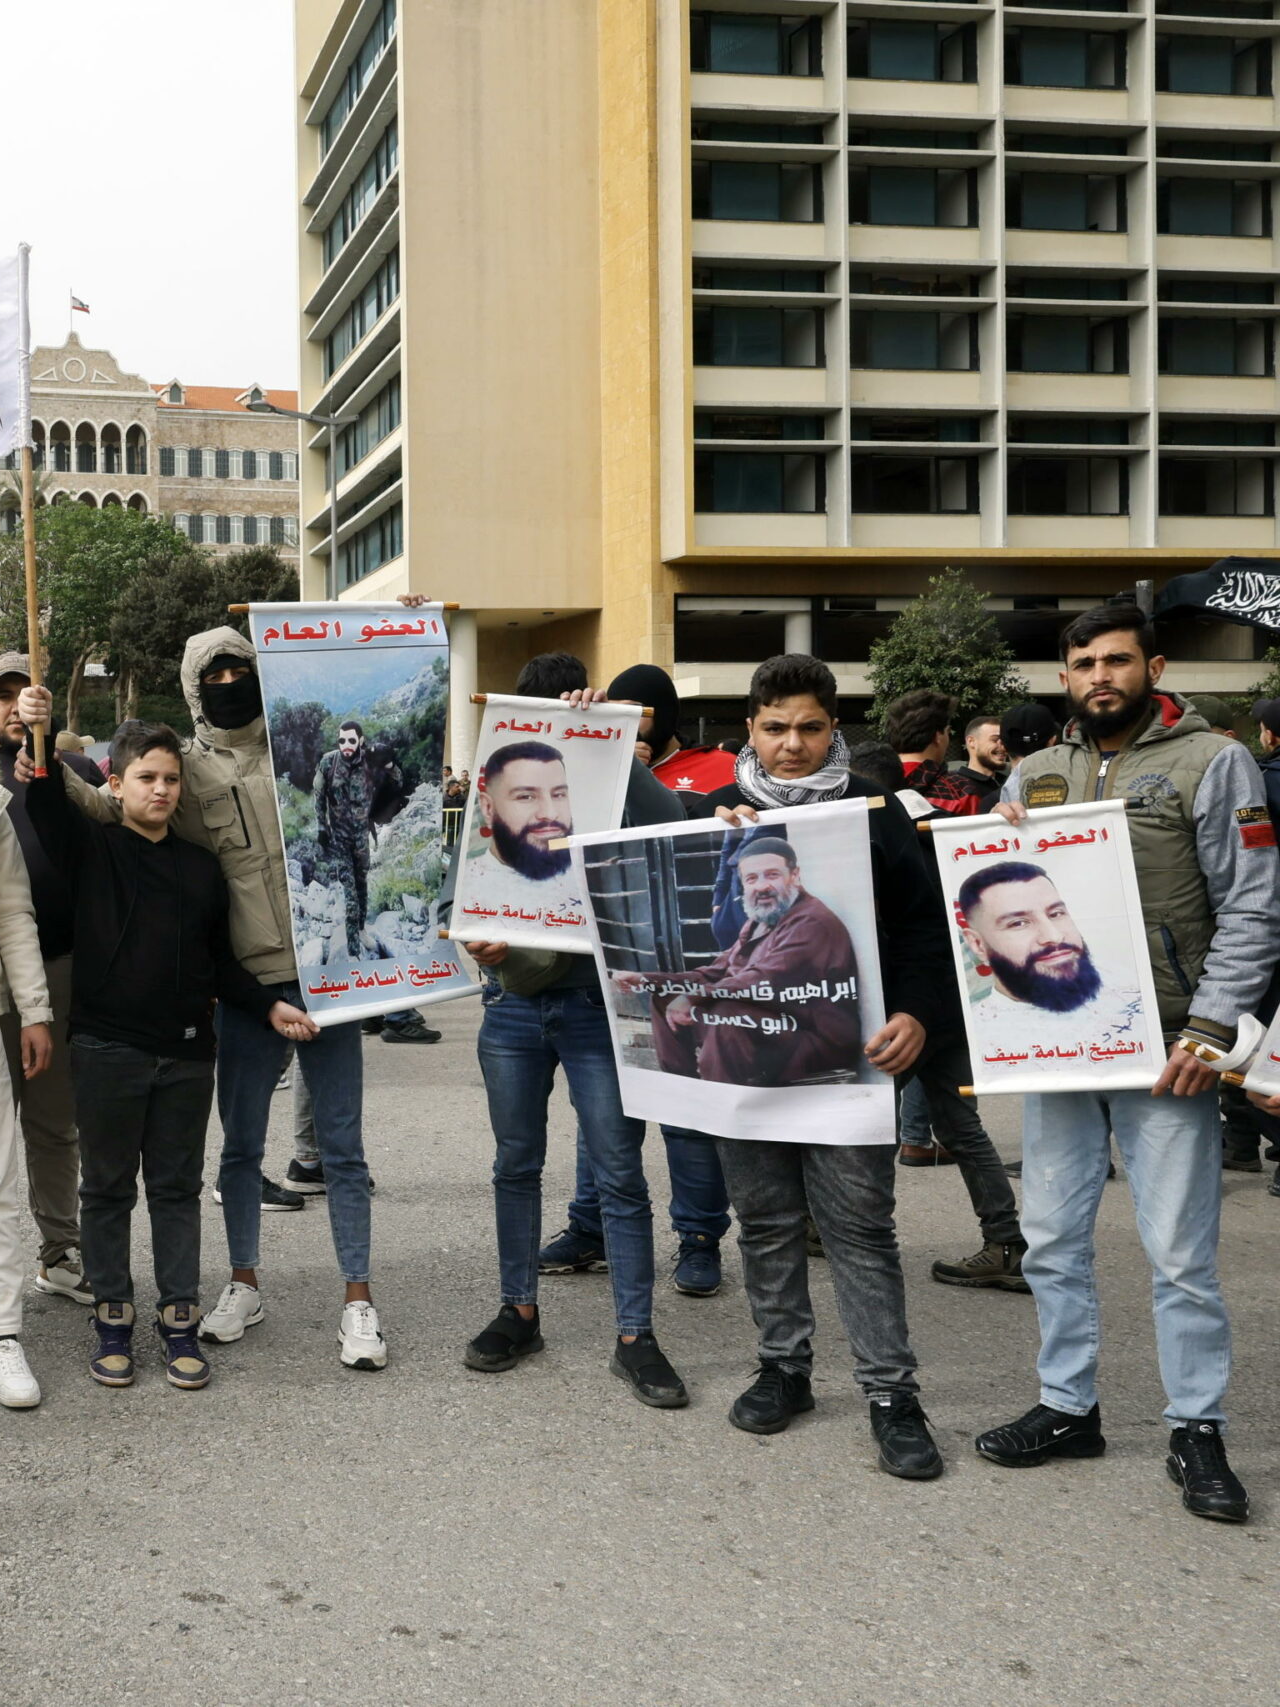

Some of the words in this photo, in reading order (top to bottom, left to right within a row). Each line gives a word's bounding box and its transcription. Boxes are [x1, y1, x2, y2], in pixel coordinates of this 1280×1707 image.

[262, 620, 342, 647] العام
[353, 618, 439, 643] العفو
[493, 718, 552, 734] العام
[559, 724, 622, 740] العفو
[952, 837, 1020, 862] العام
[1032, 827, 1109, 853] العفو
[462, 902, 498, 919] سيف
[501, 904, 542, 921] أسامة
[543, 910, 587, 927] الشيخ
[349, 965, 405, 989] أسامة
[408, 960, 461, 987] الشيخ
[307, 974, 350, 999] سيف
[710, 980, 775, 1002] قاسم
[779, 976, 858, 1005] إبراهيم
[983, 1048, 1029, 1065] سيف
[1032, 1042, 1084, 1059] أسامة
[1089, 1039, 1144, 1061] الشيخ
